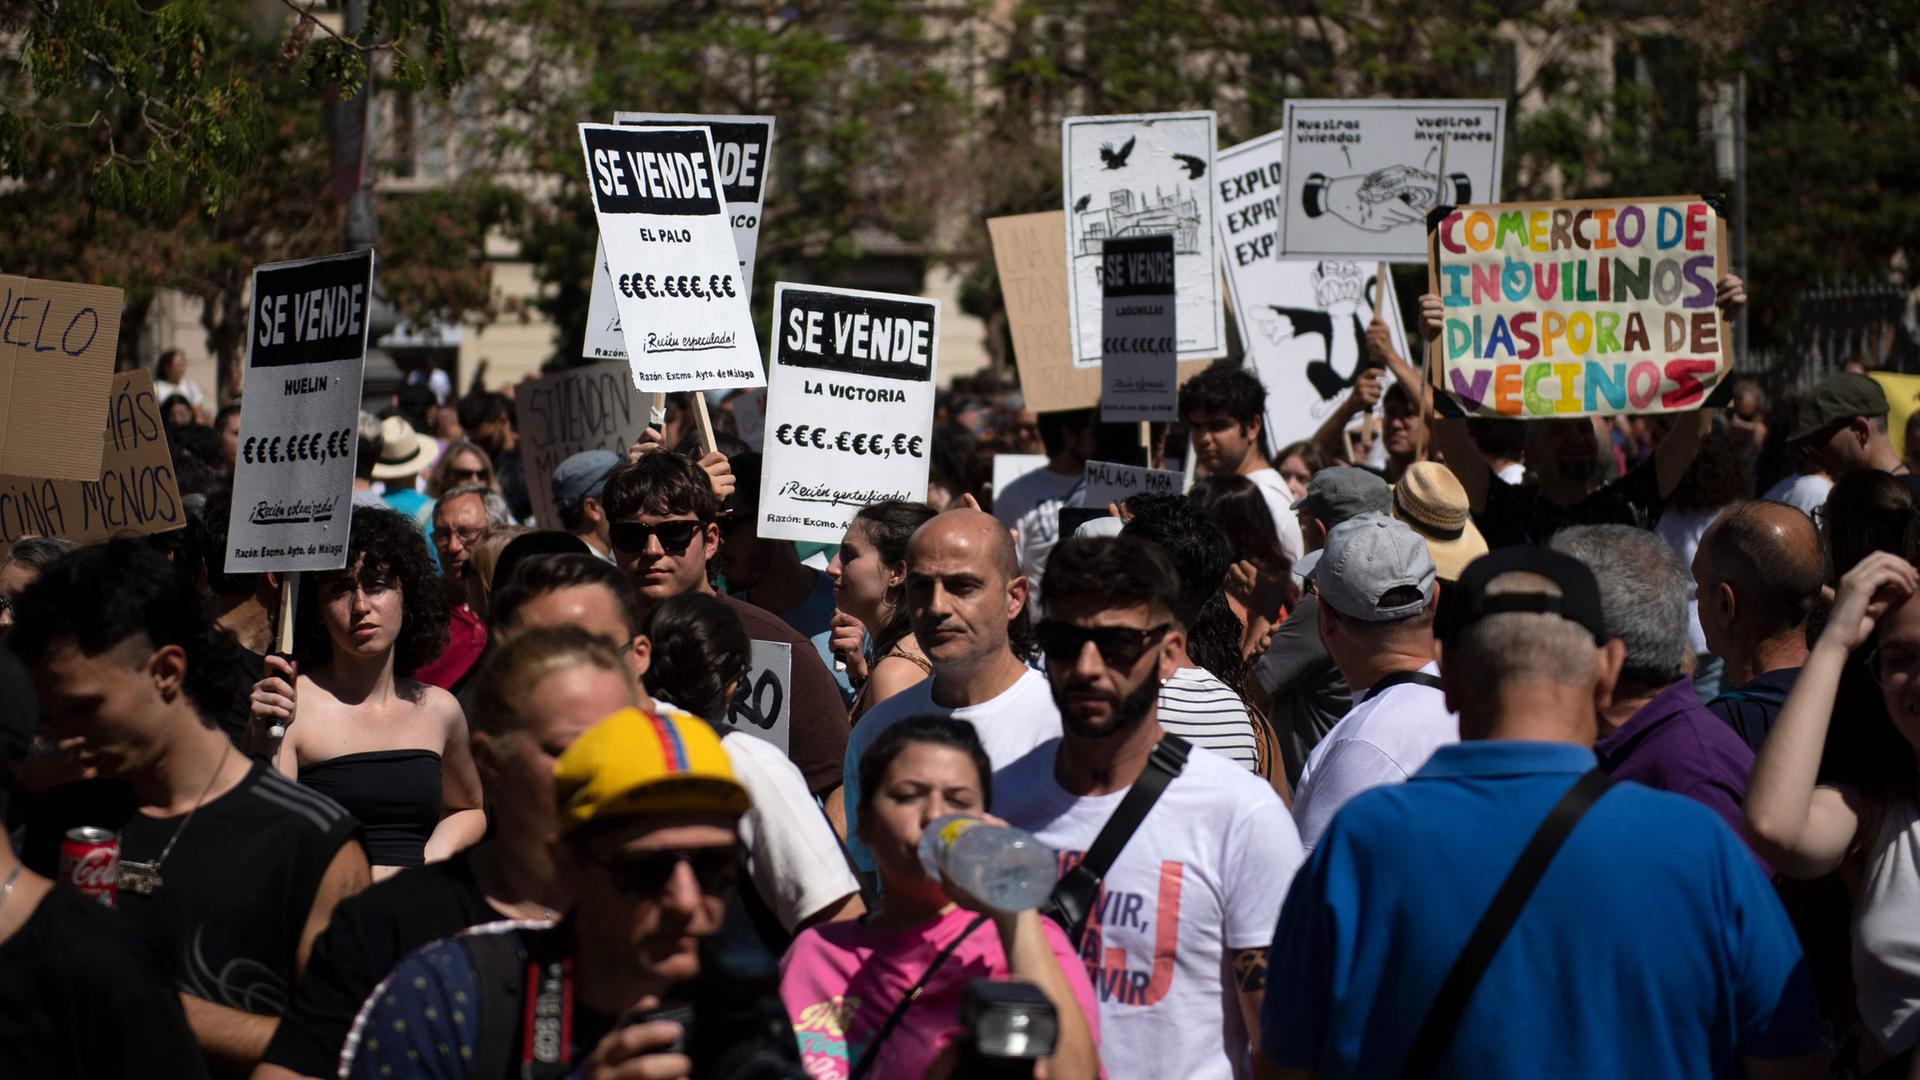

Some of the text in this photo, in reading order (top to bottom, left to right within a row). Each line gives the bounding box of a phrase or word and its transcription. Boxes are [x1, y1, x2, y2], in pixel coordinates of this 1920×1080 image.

[1296, 132, 1361, 143] viviendas
[1297, 118, 1360, 130] Nuestras
[594, 148, 712, 199] SE VENDE
[1226, 195, 1280, 235] EXPR
[1440, 203, 1708, 254] COMERCIO DE
[639, 228, 691, 243] EL PALO
[1106, 252, 1125, 287] SE
[1127, 250, 1172, 285] VENDE
[1442, 255, 1716, 308] INQUILINOS
[259, 283, 363, 348] SE VENDE
[786, 307, 931, 367] SE VENDE
[1445, 311, 1719, 359] DIASPORA DE
[284, 376, 328, 396] HUELIN
[716, 368, 727, 379] de
[727, 367, 755, 380] Málaga
[804, 381, 906, 402] LA VICTORIA
[1449, 358, 1717, 416] VECINOS
[1087, 464, 1172, 491] MÁLAGA PARA
[82, 465, 177, 532] MENOS
[767, 513, 802, 523] Razón:
[803, 517, 838, 529] Excmo.
